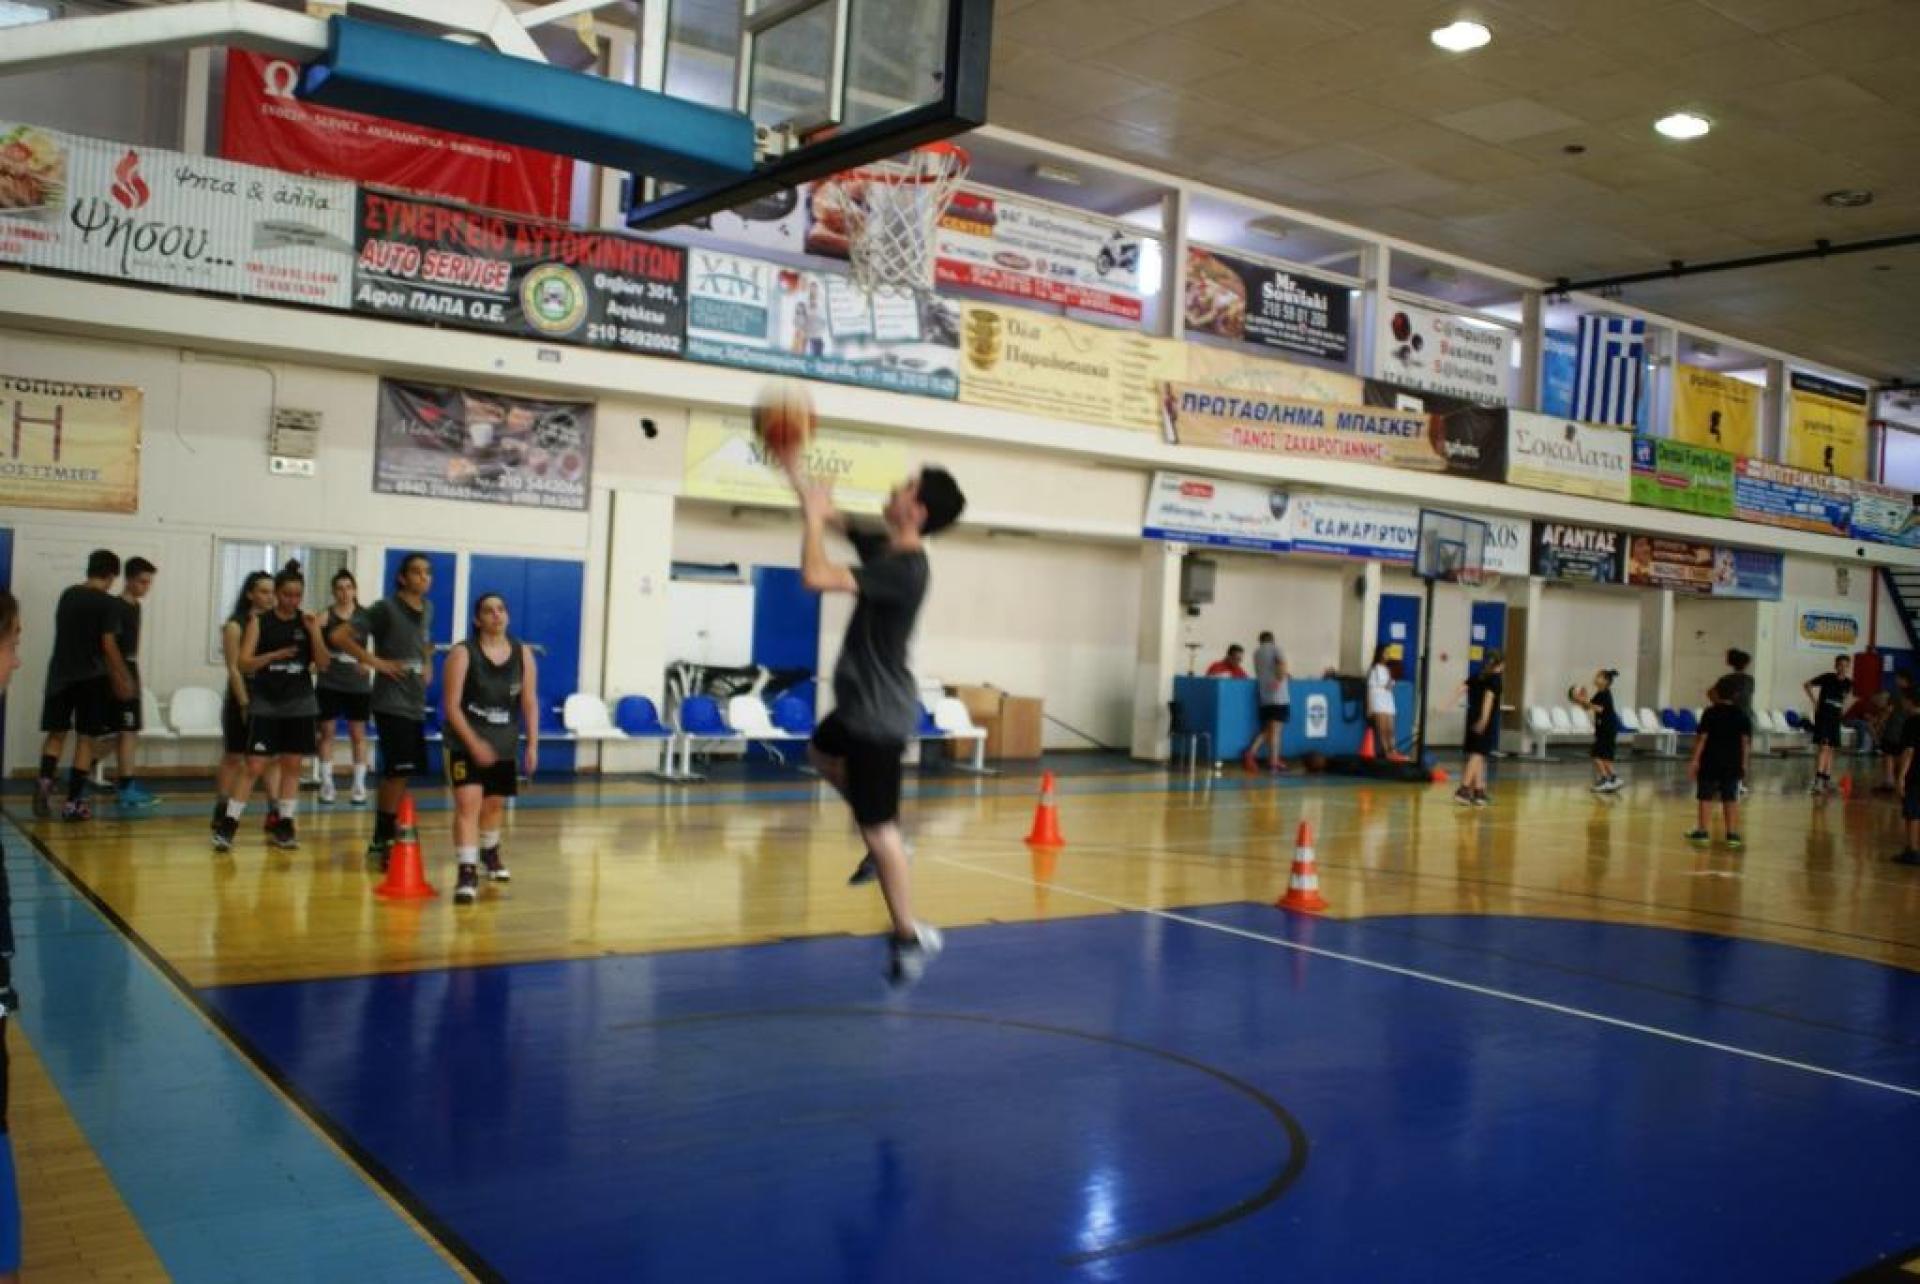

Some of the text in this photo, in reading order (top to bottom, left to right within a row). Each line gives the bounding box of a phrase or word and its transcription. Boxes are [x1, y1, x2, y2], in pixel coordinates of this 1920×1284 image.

[359, 238, 421, 279] AUTO
[421, 249, 512, 293] SERVICE
[1181, 391, 1425, 439] ΠΡΩΤΑΘΛΗΜΑ ΜΠΑΣΚΕΤ
